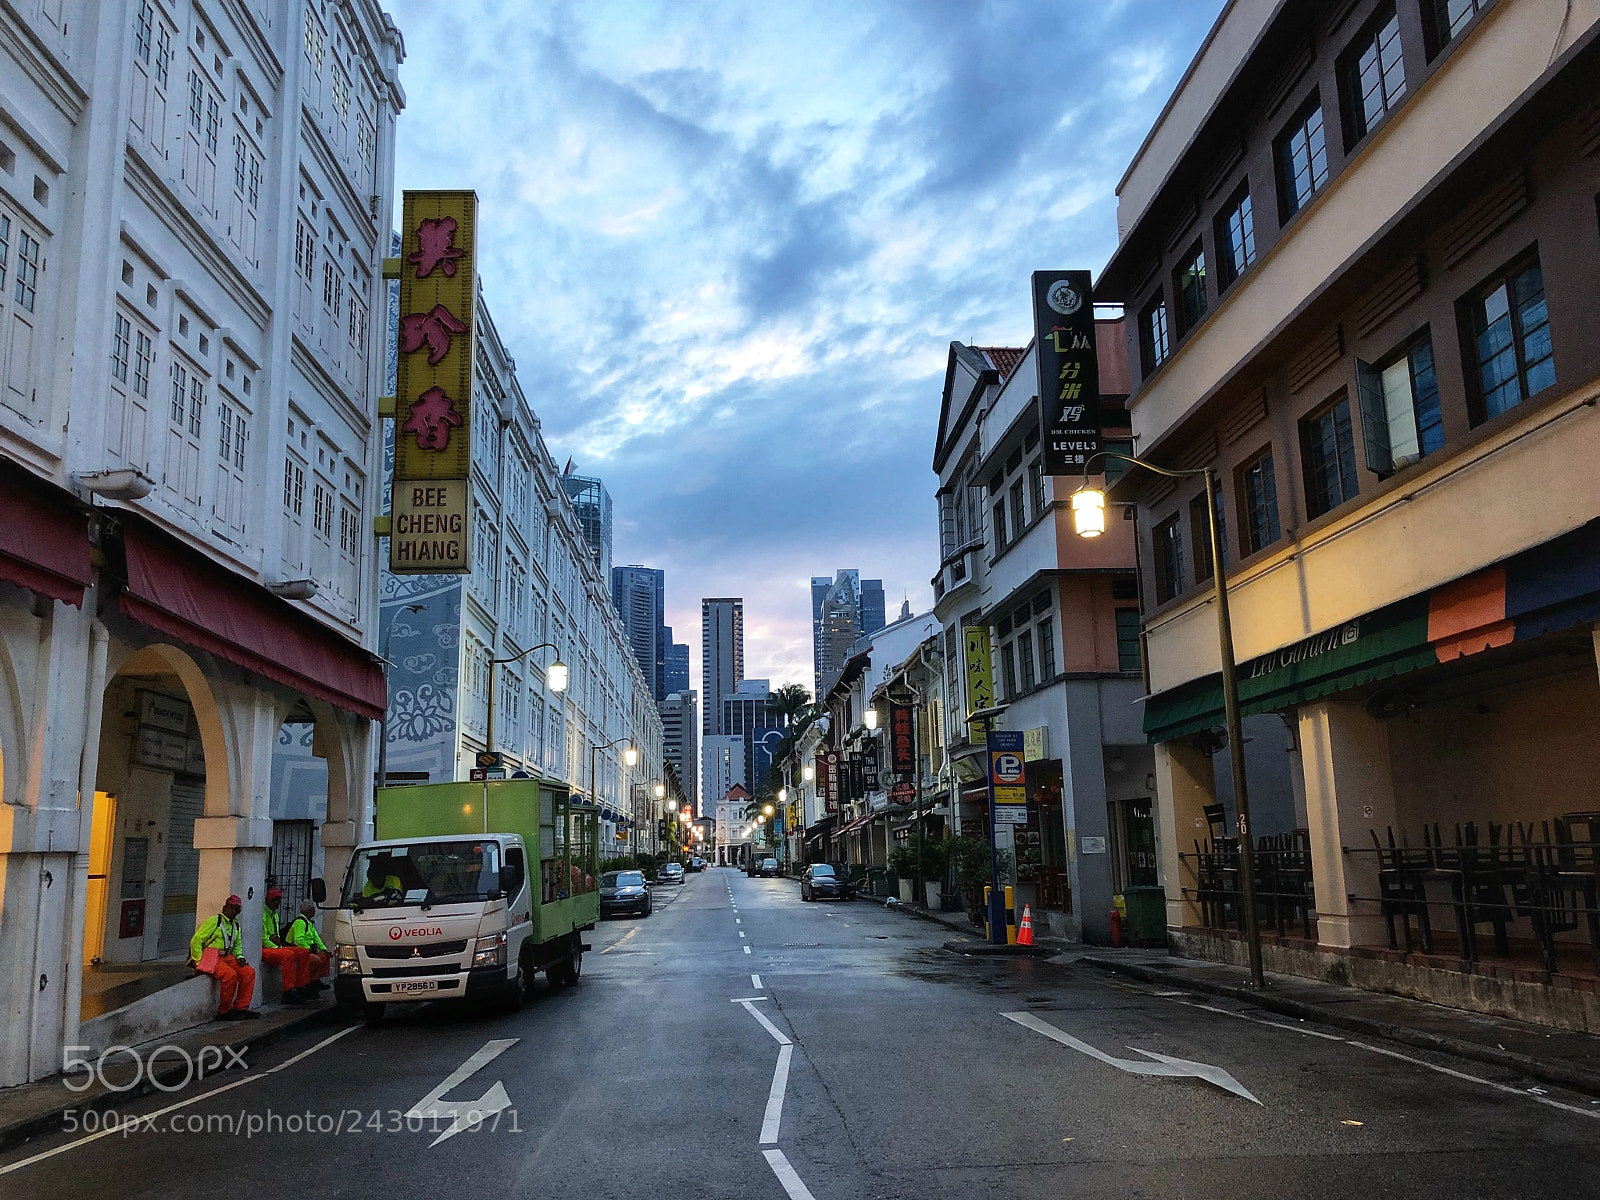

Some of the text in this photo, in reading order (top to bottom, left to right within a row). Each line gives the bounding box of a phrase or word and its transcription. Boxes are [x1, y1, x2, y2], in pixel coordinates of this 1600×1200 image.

[412, 487, 447, 507] BEE
[396, 513, 462, 534] CHENG
[397, 540, 460, 561] HIANG
[1239, 813, 1247, 835] 20
[404, 927, 443, 937] VEOLIA
